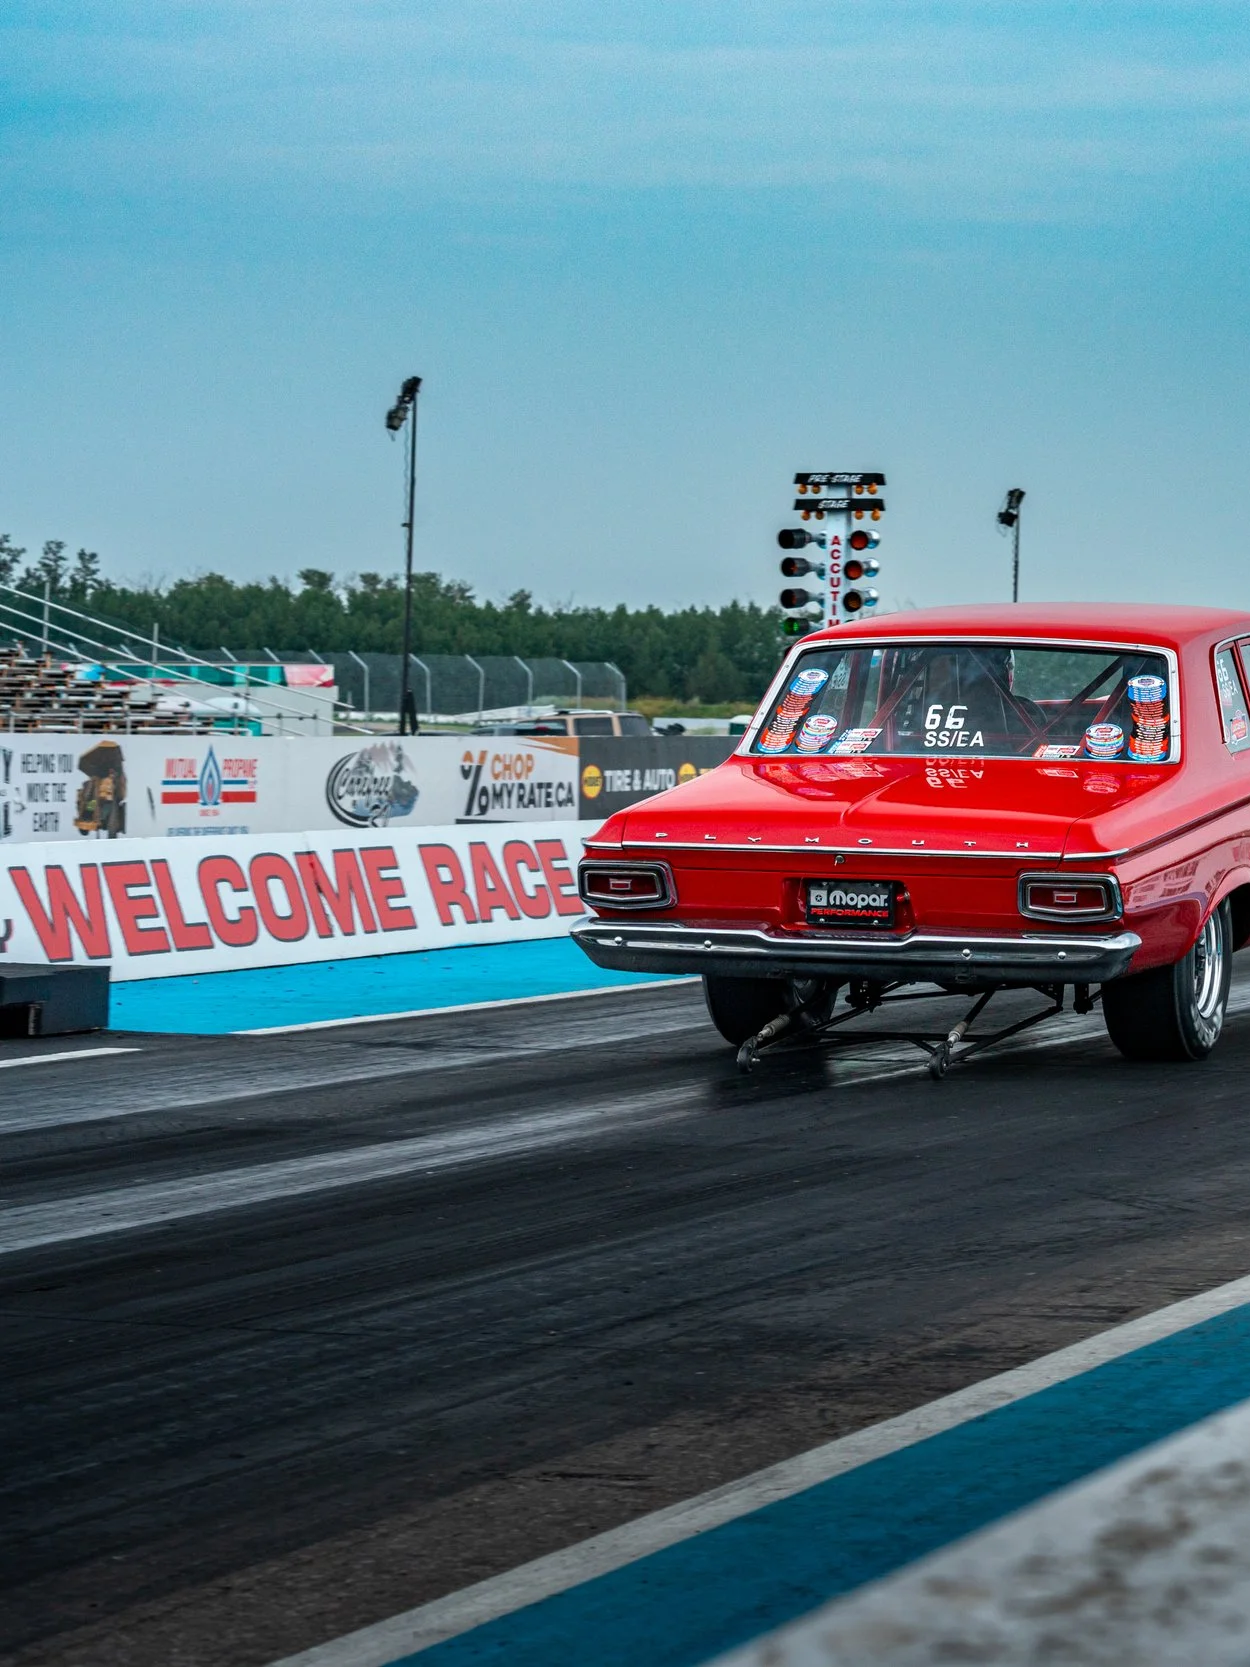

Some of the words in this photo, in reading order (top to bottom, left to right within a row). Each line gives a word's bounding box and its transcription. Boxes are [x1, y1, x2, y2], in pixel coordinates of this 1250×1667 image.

[818, 500, 850, 509] STAGE
[924, 704, 968, 730] 66
[923, 730, 985, 748] SS/EA
[21, 753, 55, 773] HELPING
[58, 753, 74, 773] YOU
[164, 758, 198, 778] MUTUAL
[222, 758, 258, 778] PROPANE
[491, 753, 535, 780] CHOP
[603, 769, 631, 792] TIRE
[632, 769, 642, 791] &
[642, 768, 676, 791] AUTO
[27, 782, 49, 802] MOVE
[51, 782, 68, 802] THE
[33, 811, 60, 832] EARTH
[655, 832, 1029, 849] PLYMOUTH
[8, 845, 417, 963] WELCOME
[417, 838, 586, 927] RACE
[810, 907, 889, 918] PERFORMANCE
